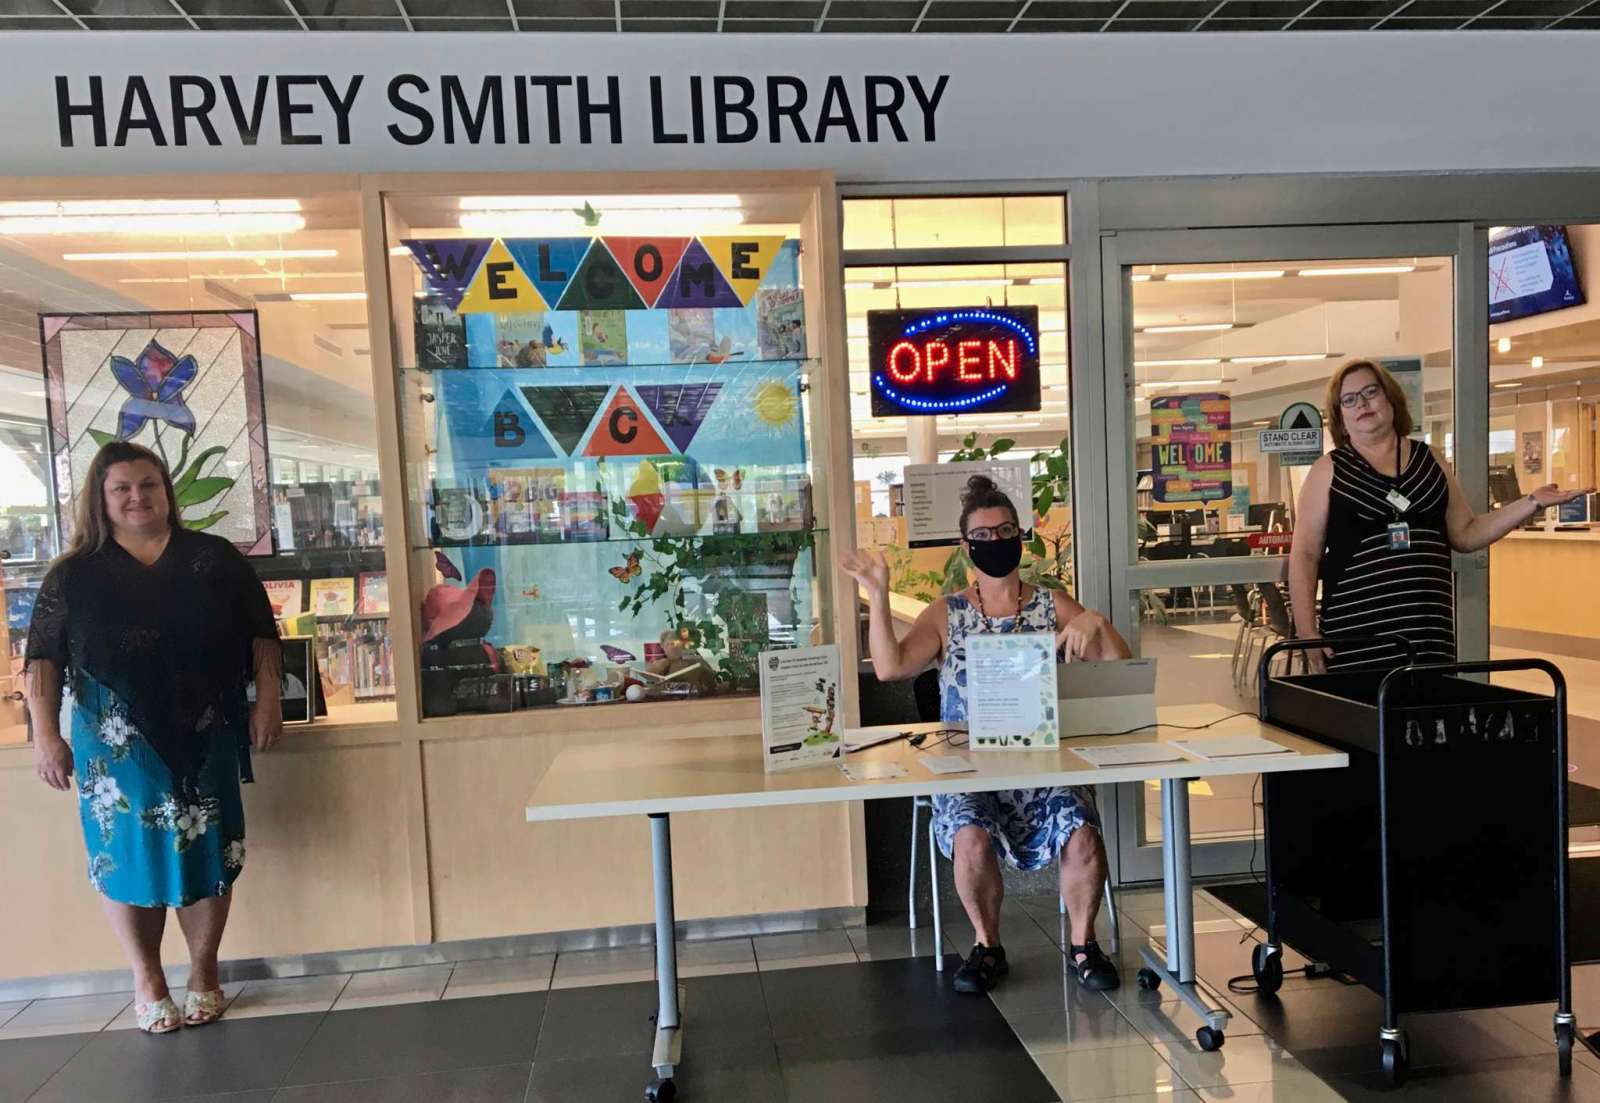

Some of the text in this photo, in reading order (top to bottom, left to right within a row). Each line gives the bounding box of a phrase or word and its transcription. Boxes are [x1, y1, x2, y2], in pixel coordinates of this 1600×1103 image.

[55, 73, 950, 147] HARVEY SMITH LIBRARY
[424, 242, 760, 300] WELCOME
[889, 339, 1017, 381] OPEN
[1263, 431, 1318, 443] STAND CLEAR
[1158, 443, 1225, 465] WELCOME
[1258, 534, 1293, 545] AUTOMAT
